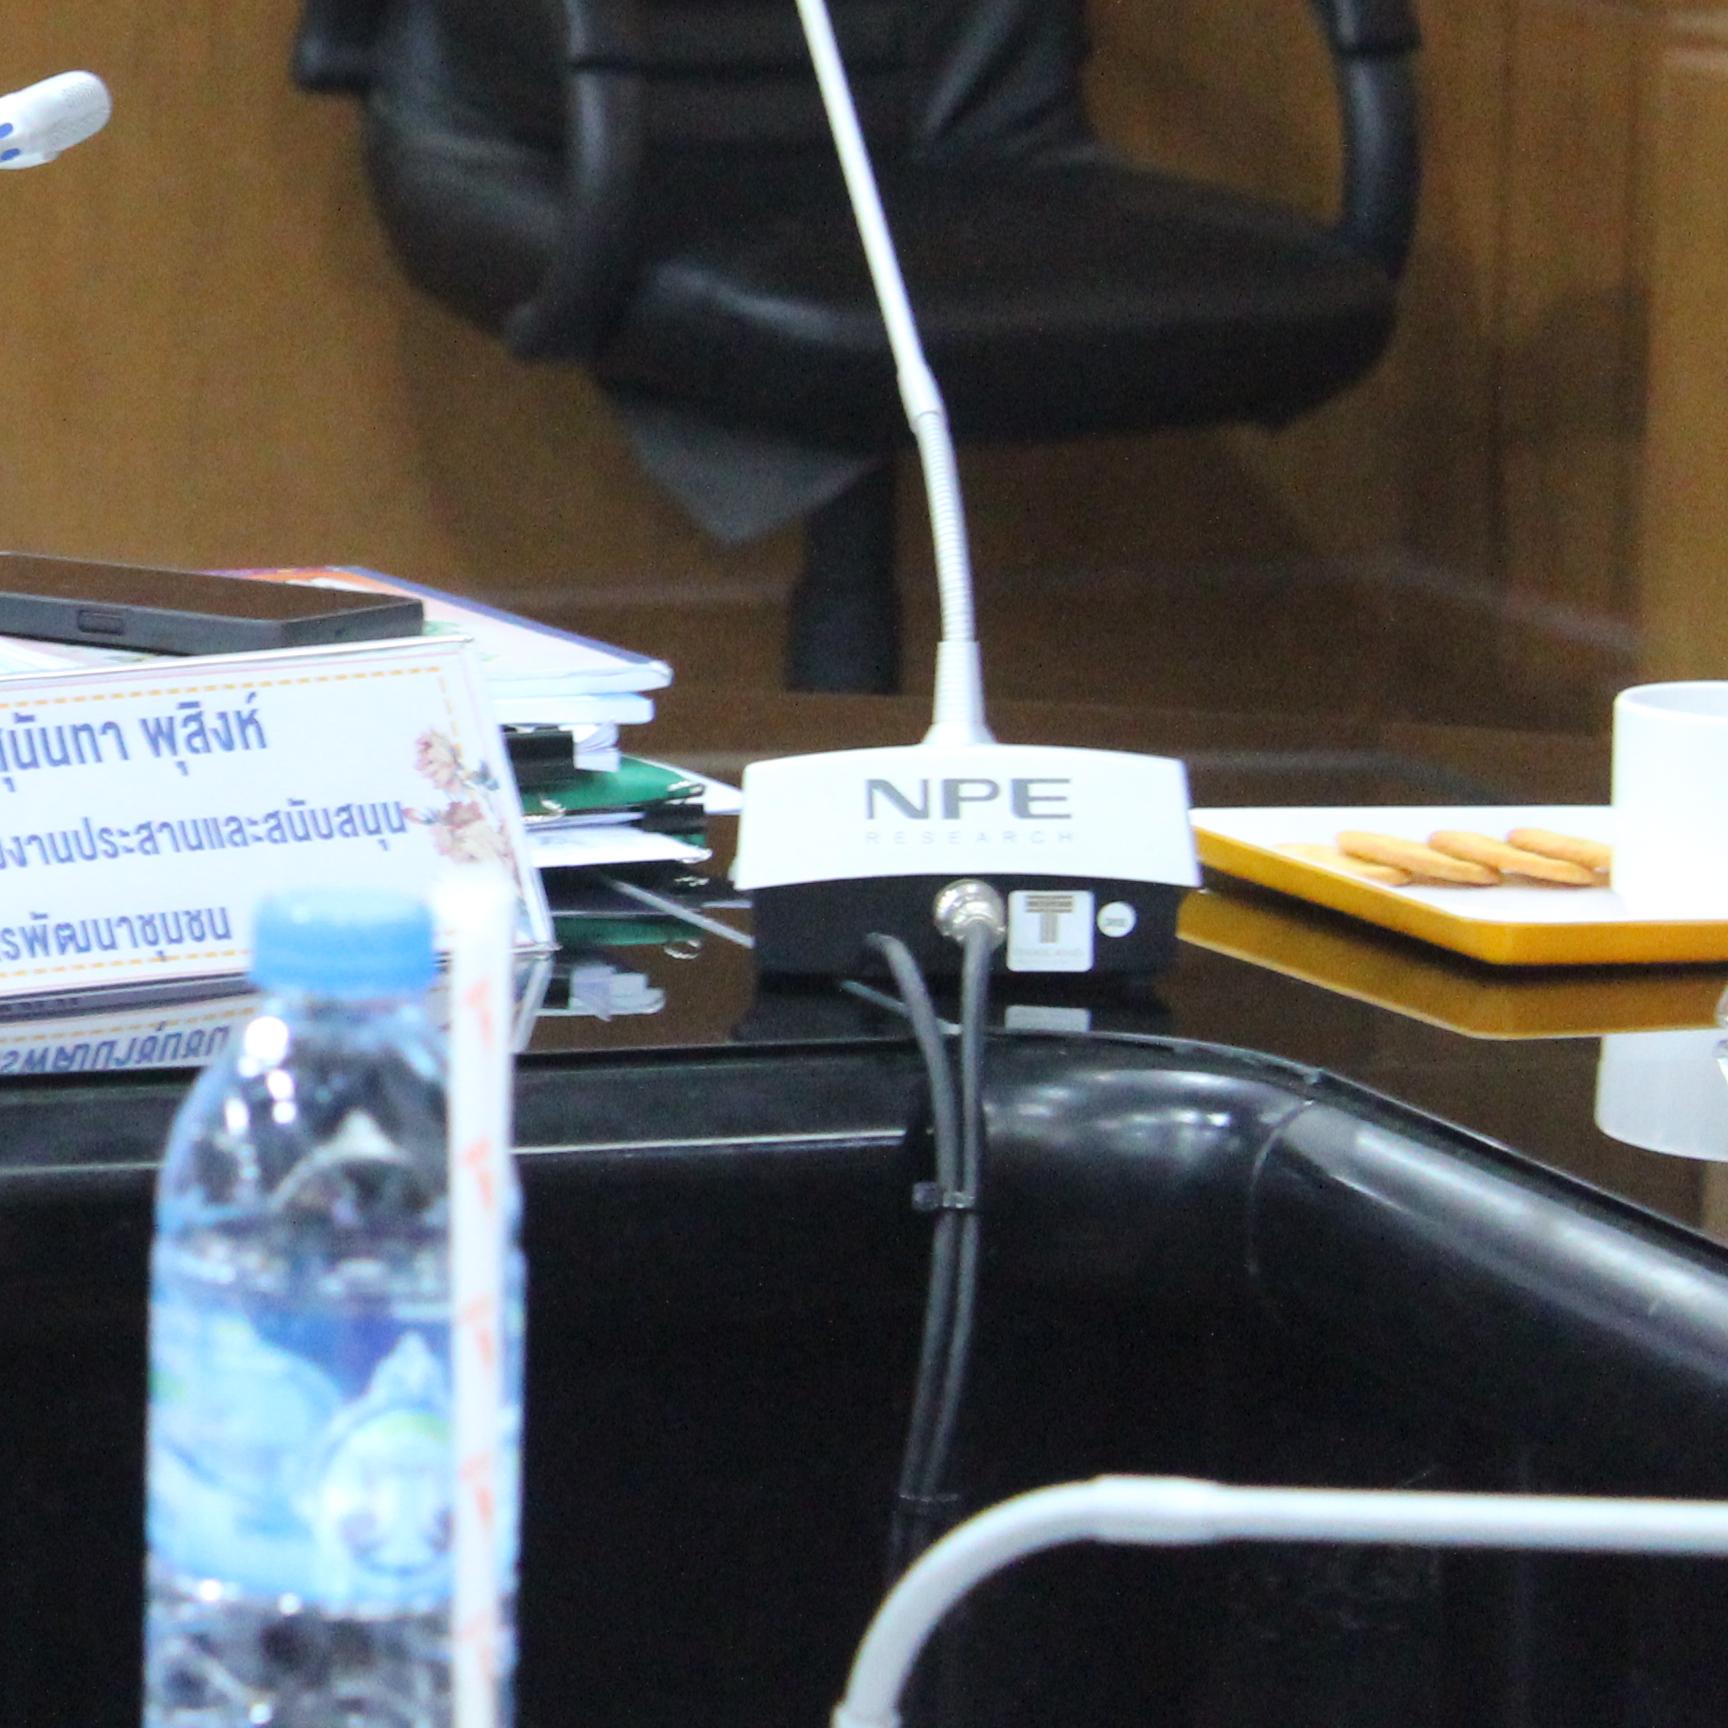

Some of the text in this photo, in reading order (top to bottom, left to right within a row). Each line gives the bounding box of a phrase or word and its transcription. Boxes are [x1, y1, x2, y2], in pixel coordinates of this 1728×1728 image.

[138, 691, 268, 776] พุสิงห์
[865, 778, 1072, 820] NPE
[864, 830, 1074, 845] RESEARCH
